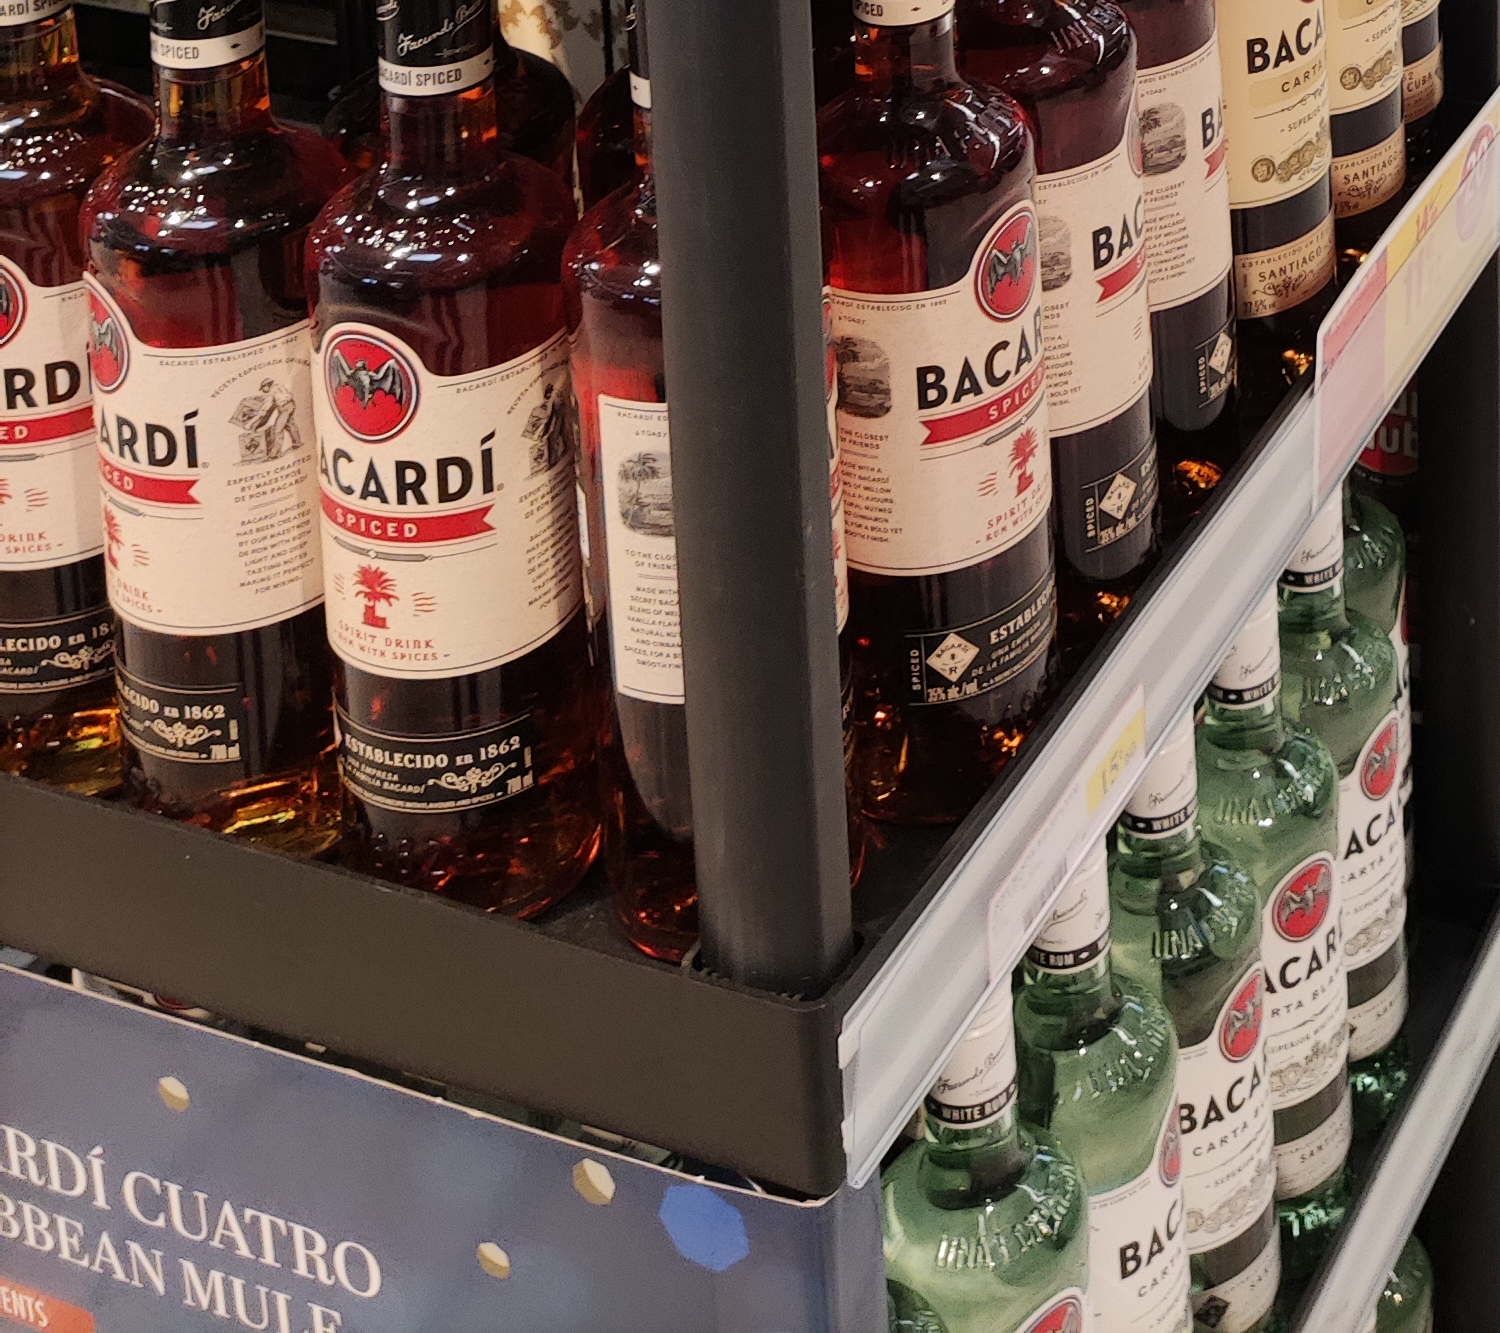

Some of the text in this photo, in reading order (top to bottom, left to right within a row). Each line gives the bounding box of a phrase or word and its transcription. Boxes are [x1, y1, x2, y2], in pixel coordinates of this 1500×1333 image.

[160, 45, 200, 61] SPICED
[1246, 7, 1324, 75] BACA
[415, 66, 463, 87] SPICED
[1406, 72, 1433, 93] CUBA
[915, 304, 1043, 411] BACAR
[335, 507, 419, 540] SPICED
[384, 636, 434, 650] DRINK
[909, 648, 922, 691] SPICED
[183, 703, 226, 721] 1862
[478, 736, 522, 763] 1862
[1151, 807, 1190, 831] WHITE
[940, 1101, 982, 1123] WHITE
[1178, 1061, 1263, 1135] BACA
[122, 1169, 383, 1300] CUATRO
[0, 1193, 343, 1333] BBEAN MULE
[0, 1283, 49, 1330] ENTS
